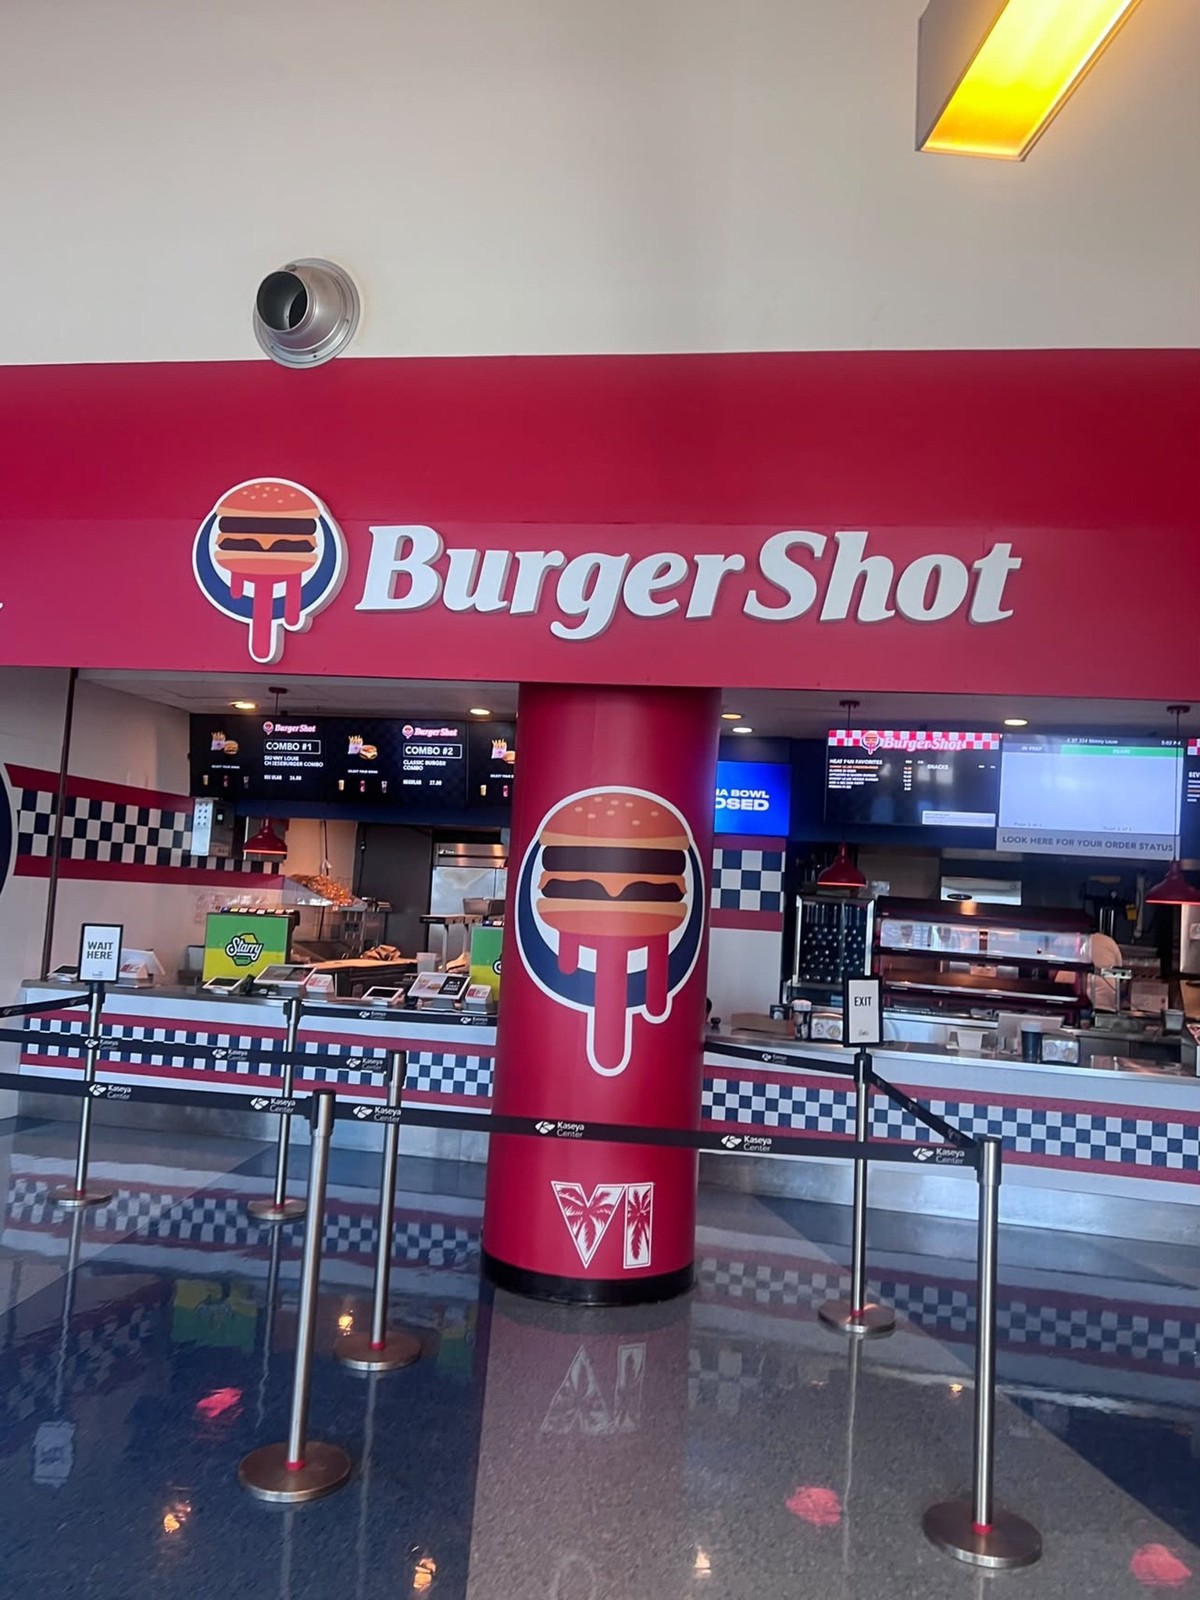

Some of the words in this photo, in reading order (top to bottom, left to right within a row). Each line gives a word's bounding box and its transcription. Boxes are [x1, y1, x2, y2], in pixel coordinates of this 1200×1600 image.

[266, 742, 300, 751] COMBO
[302, 743, 312, 751] #1
[405, 746, 440, 755] COMBO
[442, 747, 454, 756] #2
[730, 789, 770, 799] BOWL
[1002, 835, 1028, 844] LOOK
[1030, 837, 1053, 845] HERE
[1056, 838, 1074, 846] FOR
[1077, 839, 1103, 848] YOUR
[1105, 840, 1137, 850] ORDER
[1138, 842, 1173, 852] STATUS
[87, 941, 114, 950] WAIT
[226, 937, 263, 961] Starry
[86, 950, 113, 960] HERE
[854, 996, 872, 1007] EXIT
[108, 1084, 132, 1093] Kaseya
[107, 1091, 131, 1100] Center
[270, 1097, 296, 1107] Kaseya
[269, 1104, 295, 1113] Center
[374, 1106, 402, 1116] Kaseya
[373, 1113, 401, 1123] Center
[556, 1121, 585, 1132] Kaseya
[556, 1129, 584, 1139] Center
[743, 1135, 772, 1146] Kaseya
[743, 1143, 771, 1153] Center
[935, 1147, 965, 1158] Kaseya
[935, 1155, 965, 1165] Center
